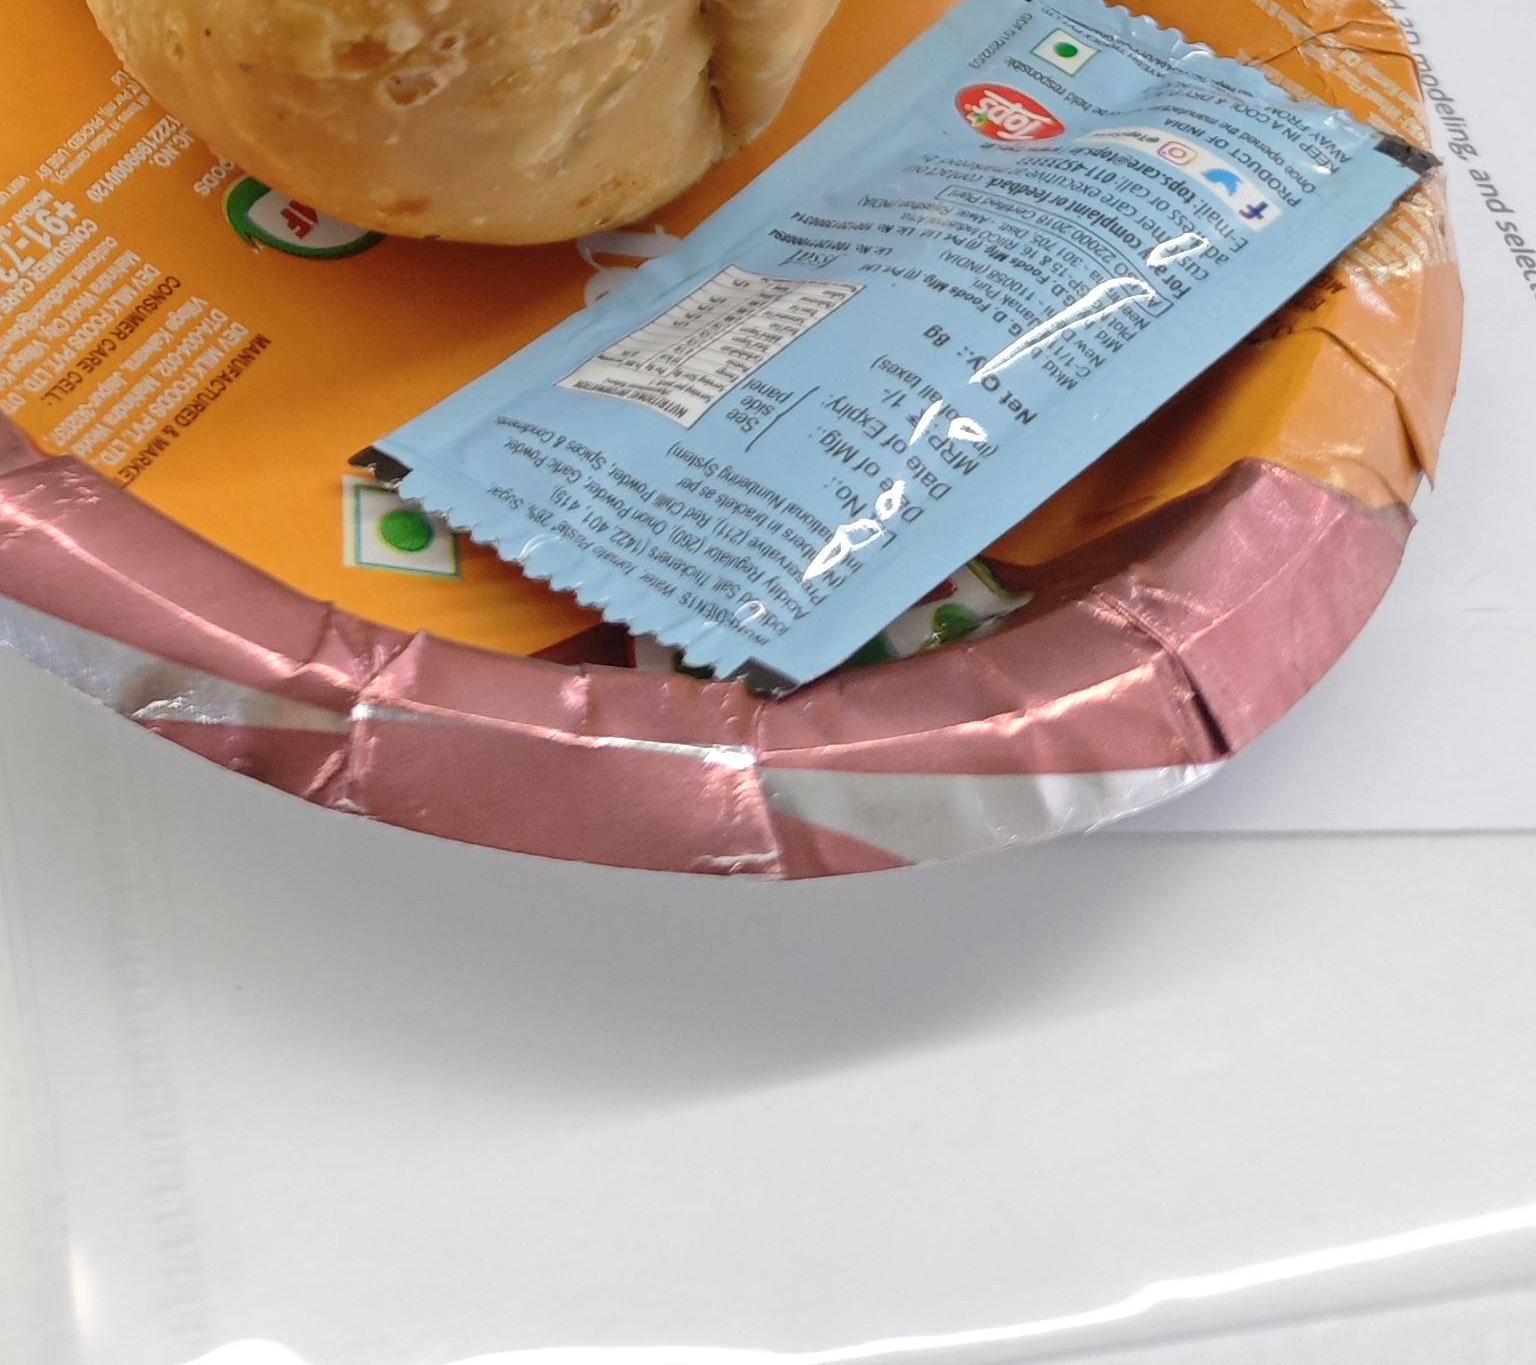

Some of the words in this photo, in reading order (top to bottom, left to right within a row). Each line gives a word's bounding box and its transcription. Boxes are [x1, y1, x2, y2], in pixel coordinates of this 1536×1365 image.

[1062, 91, 1095, 112] held
[966, 87, 1051, 150] Tops
[1162, 115, 1207, 138] INDIA
[1216, 122, 1241, 140] the
[1267, 119, 1281, 130] A
[1278, 126, 1301, 144] IN
[1416, 54, 1476, 162] modeling,
[1470, 168, 1508, 215] and
[1203, 132, 1231, 150] OF
[1233, 132, 1289, 166] opened
[1297, 138, 1340, 174] KEEP
[1310, 130, 1350, 162] AWAY
[1108, 175, 1152, 201] call:
[1225, 145, 1303, 207] PRODUCT
[1282, 163, 1318, 194] Once
[1044, 196, 1067, 208] or
[1096, 194, 1137, 220] care
[1145, 194, 1172, 213] or
[1058, 197, 1150, 254] complaint
[1187, 197, 1248, 254] E-mail:
[25, 217, 97, 283] CONSUMER
[1131, 213, 1211, 283] cusmer
[1138, 245, 1170, 277] ay
[1006, 254, 1051, 284] Foods
[1158, 270, 1191, 301] For
[103, 283, 138, 314] MILK
[109, 274, 182, 342] CONSUMER
[944, 284, 992, 313] Foods
[996, 294, 1041, 328] Janak
[64, 306, 115, 352] FOODS
[917, 324, 953, 348] 8g
[75, 336, 118, 375] CARE
[186, 345, 225, 380] MILK
[952, 344, 1002, 392] Qy.:
[1071, 335, 1106, 368] New
[39, 368, 84, 408] CELL:
[171, 333, 271, 429] MANUFACTURED
[867, 355, 926, 390] taxes)
[145, 372, 198, 421] FOODS
[741, 377, 792, 402] panel
[916, 383, 944, 405] all
[722, 408, 760, 434] See
[736, 395, 777, 420] side
[815, 390, 891, 440] Expiry:
[997, 389, 1039, 426] Net
[160, 424, 179, 440] &
[549, 435, 568, 449] &
[877, 434, 912, 456] of
[561, 436, 611, 469] Spices
[663, 441, 724, 475] System)
[848, 458, 884, 479] of
[543, 458, 584, 485] Garlic
[605, 461, 656, 502] Powder,
[674, 473, 703, 491] per
[715, 465, 789, 508] Numbering
[900, 453, 952, 503] Date
[579, 476, 633, 519] Powder,
[698, 485, 718, 498] as
[872, 476, 925, 525] De
[680, 508, 712, 529] Red
[712, 493, 769, 527] brackets
[763, 519, 784, 535] in
[698, 541, 767, 584] Regulator
[758, 576, 812, 623] Acidity
